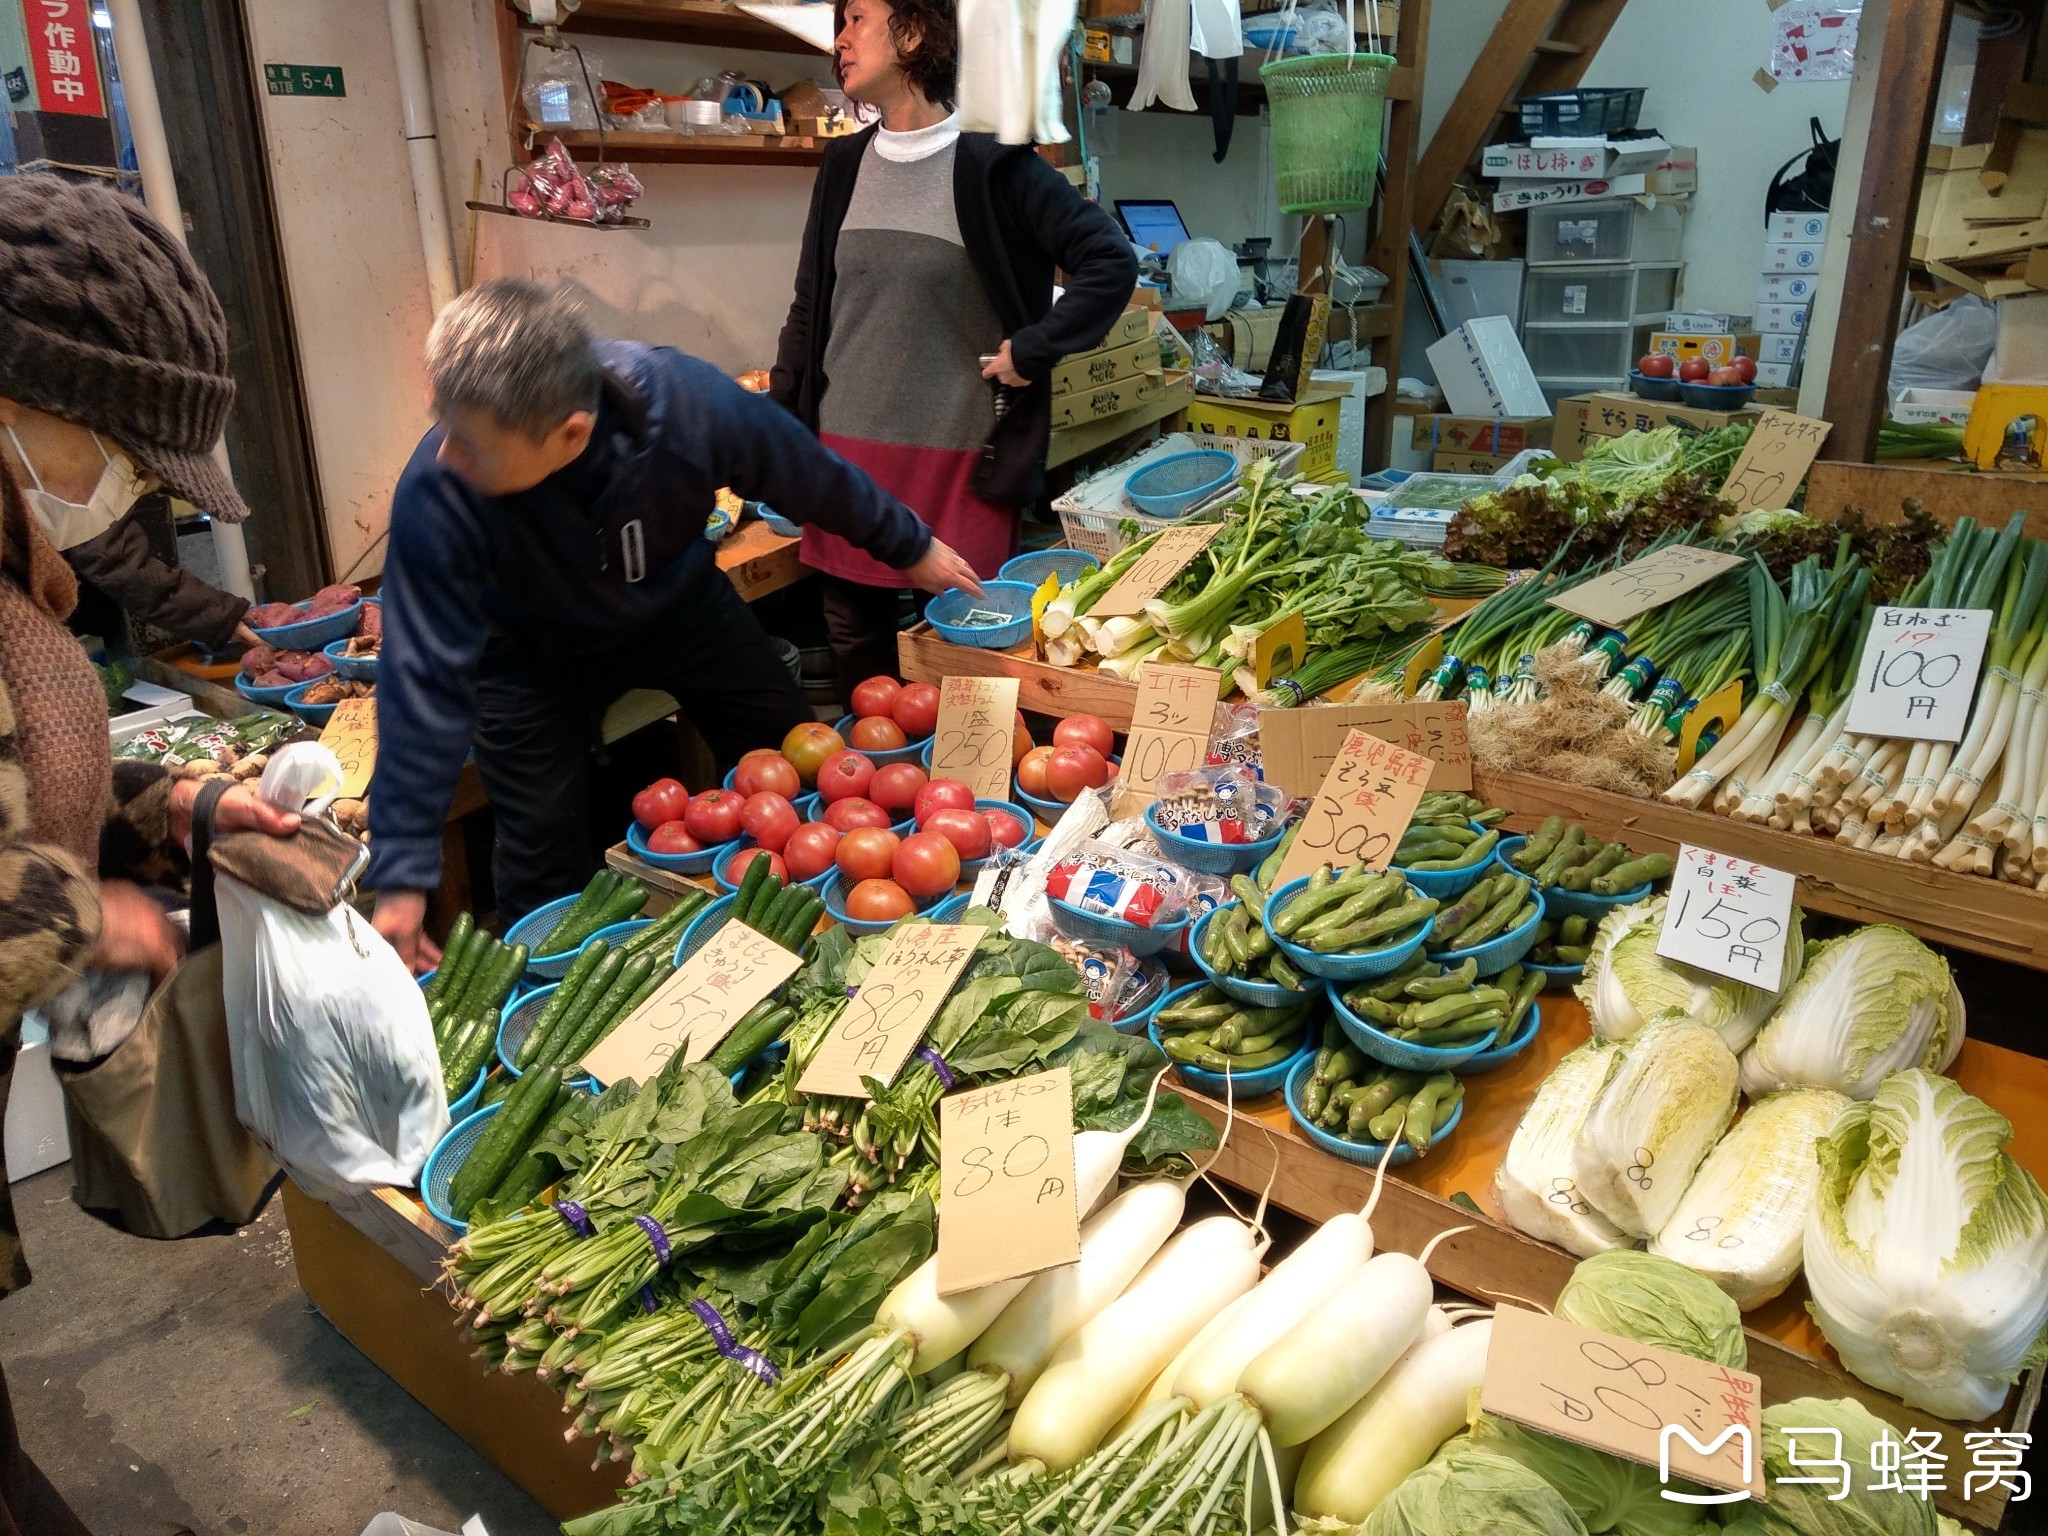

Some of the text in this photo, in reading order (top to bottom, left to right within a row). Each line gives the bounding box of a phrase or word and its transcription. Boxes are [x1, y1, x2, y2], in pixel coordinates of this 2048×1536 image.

[301, 71, 335, 90] 5-4
[1516, 153, 1566, 172] ほし柿
[1516, 184, 1581, 205] きゅうり
[1119, 557, 1180, 586] 100
[1609, 564, 1686, 587] 40
[1883, 609, 1967, 628] 白ねぎ
[1869, 649, 1962, 694] 100
[1905, 695, 1938, 720] 円
[937, 729, 1008, 769] 250
[1126, 733, 1197, 784] 100
[1343, 731, 1428, 788] 鹿児島産
[1337, 760, 1397, 800] そら豆
[1301, 795, 1392, 864] 300
[1684, 848, 1767, 879] くまもと
[1674, 888, 1782, 944] 150
[895, 926, 964, 949] 小倉産
[1727, 944, 1764, 974] 円
[634, 974, 728, 1043] 150
[841, 983, 924, 1041] 80
[852, 1034, 889, 1071] 円
[953, 1134, 1051, 1197] 80
[1036, 1176, 1065, 1205] 円
[1579, 1340, 1668, 1431] 80
